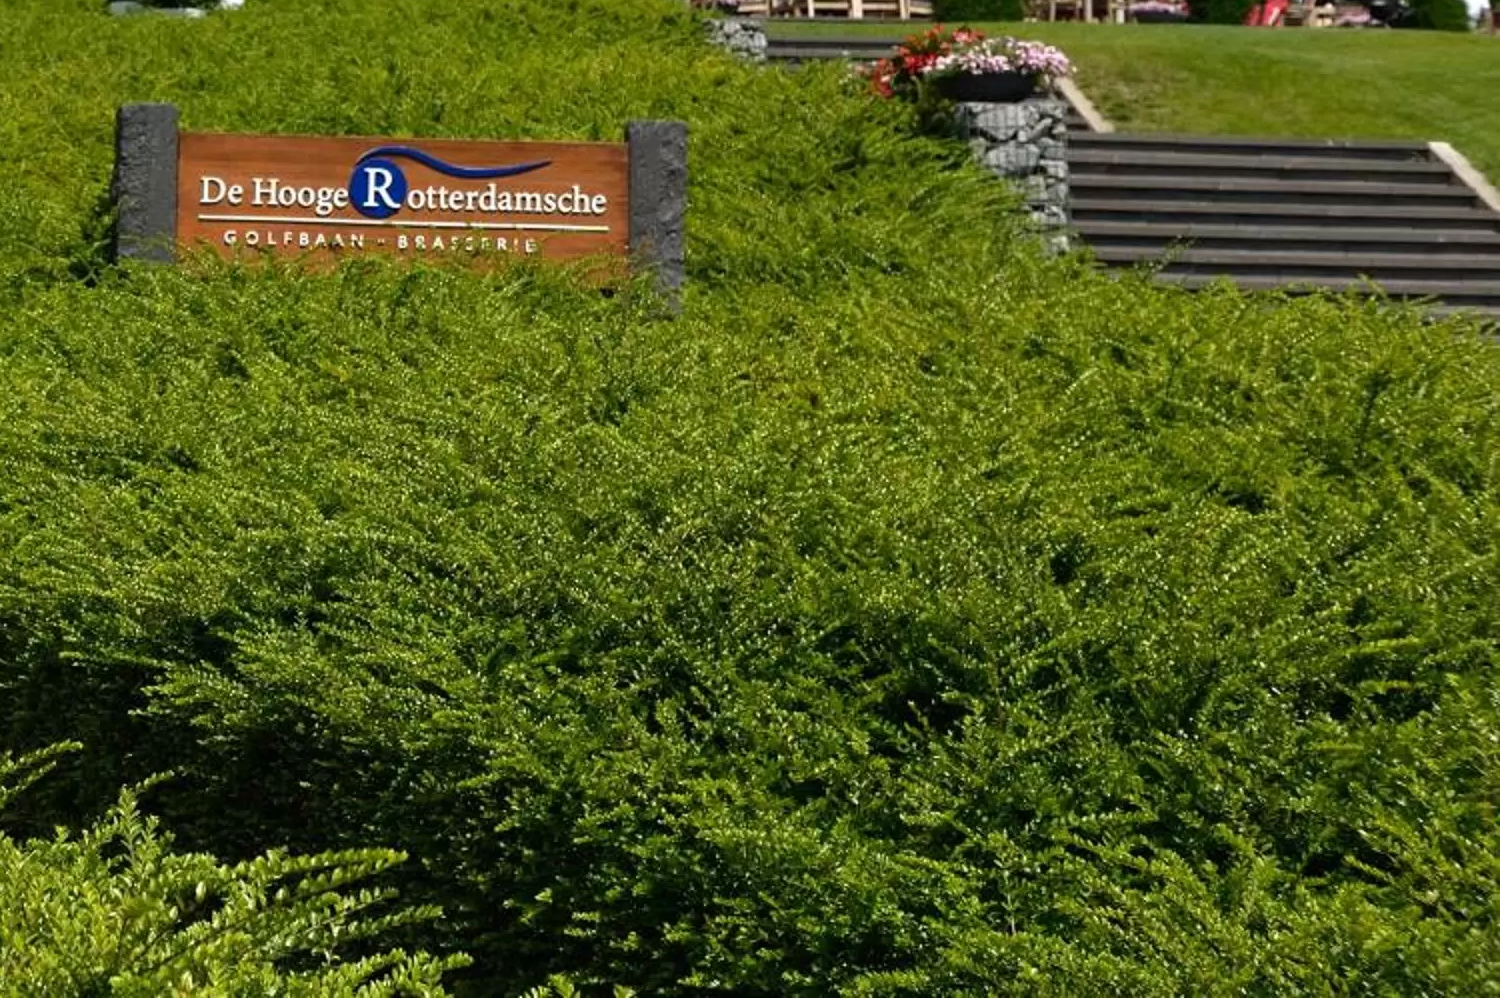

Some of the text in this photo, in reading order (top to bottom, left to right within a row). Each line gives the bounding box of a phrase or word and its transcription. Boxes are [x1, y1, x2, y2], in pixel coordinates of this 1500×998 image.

[200, 167, 607, 216] De Hooge Rotterdamsche
[223, 230, 365, 248] GOLFBAAN
